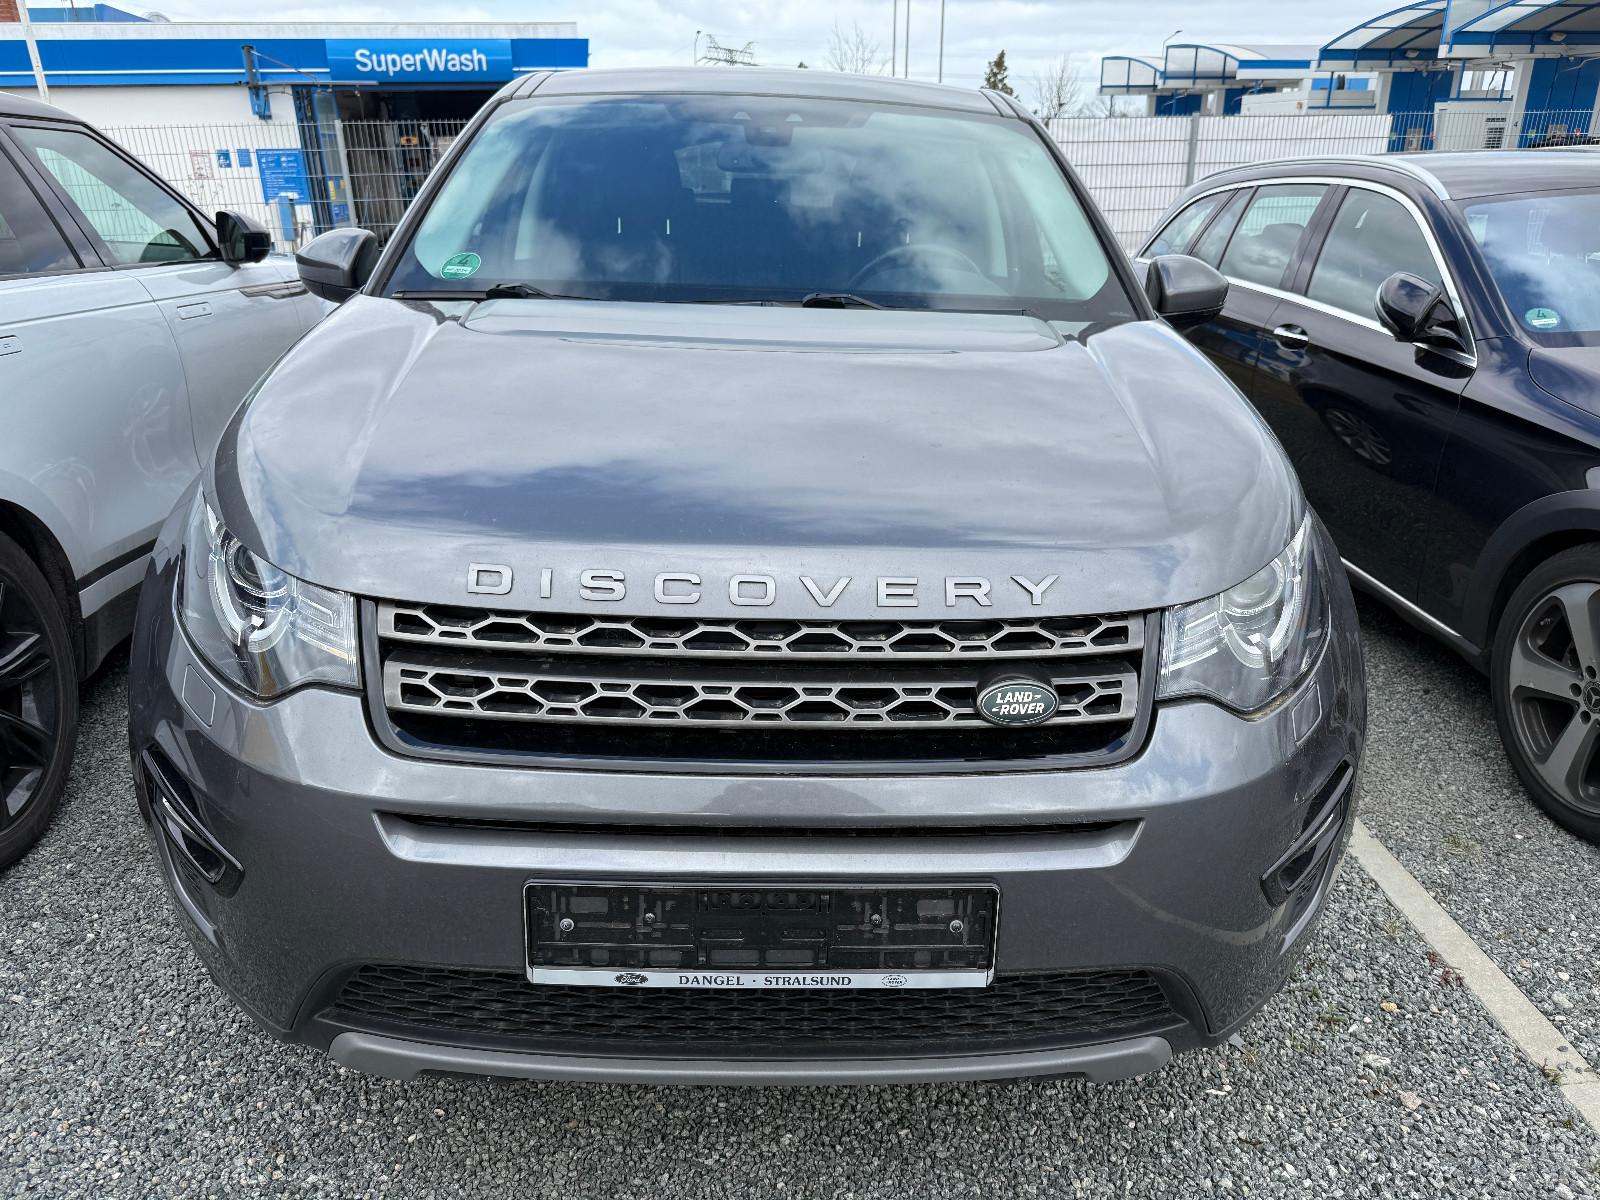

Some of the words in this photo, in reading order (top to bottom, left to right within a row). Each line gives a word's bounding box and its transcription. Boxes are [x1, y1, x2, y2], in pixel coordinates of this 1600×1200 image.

[355, 48, 487, 77] SuperWash
[457, 254, 473, 266] 4
[467, 562, 1061, 607] DISCOVERY
[678, 975, 745, 986] DANGEL
[763, 976, 852, 986] STRALSUND
